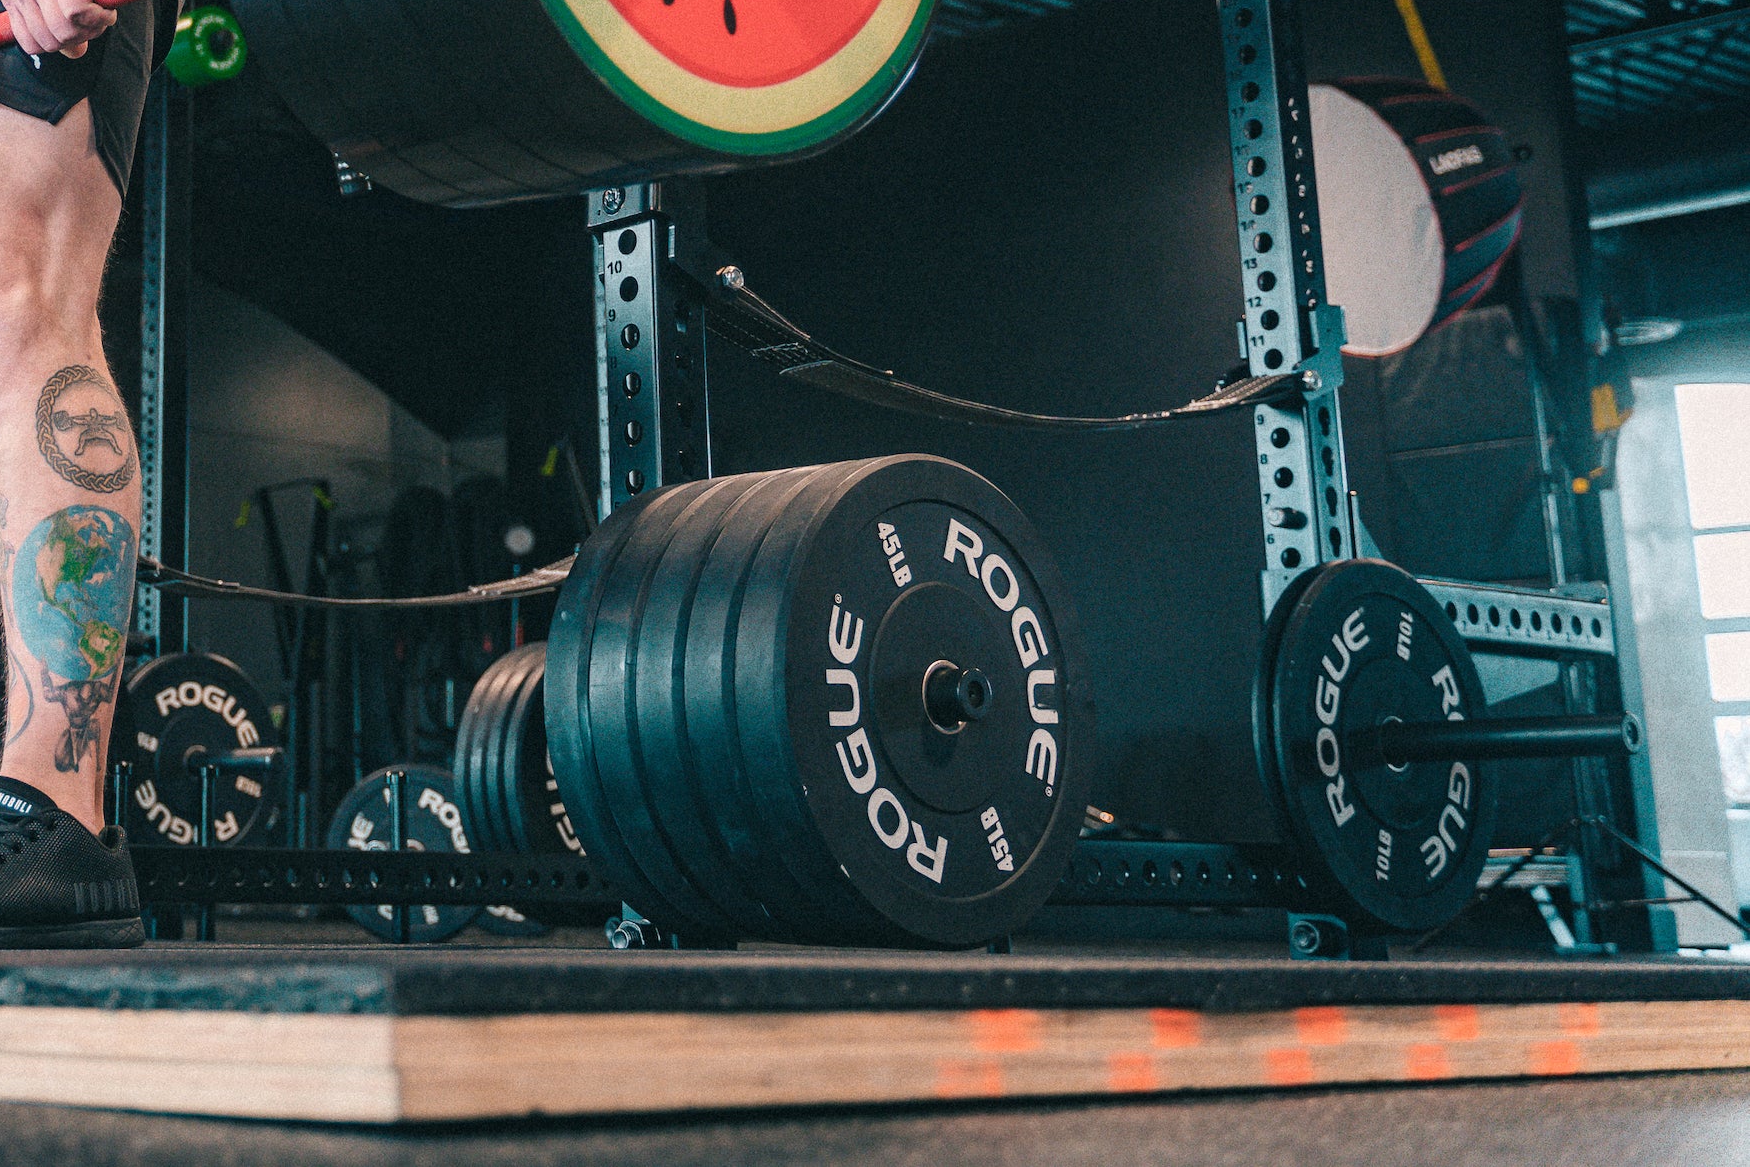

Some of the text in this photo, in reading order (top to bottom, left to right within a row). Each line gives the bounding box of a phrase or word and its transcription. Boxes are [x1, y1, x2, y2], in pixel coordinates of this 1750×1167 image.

[607, 260, 622, 275] 10
[1244, 258, 1258, 270] 13
[1247, 296, 1262, 308] 12
[1251, 335, 1264, 347] 11
[876, 521, 912, 588] 45LB
[943, 518, 1060, 786] ROGUE
[155, 681, 260, 748] ROGUE
[825, 604, 949, 884] ROGUE
[1315, 610, 1370, 828] ROGUE
[135, 780, 240, 845] RGUE
[417, 787, 471, 854] ROG
[980, 807, 1014, 872] 45LB
[1375, 829, 1393, 882] 10LB
